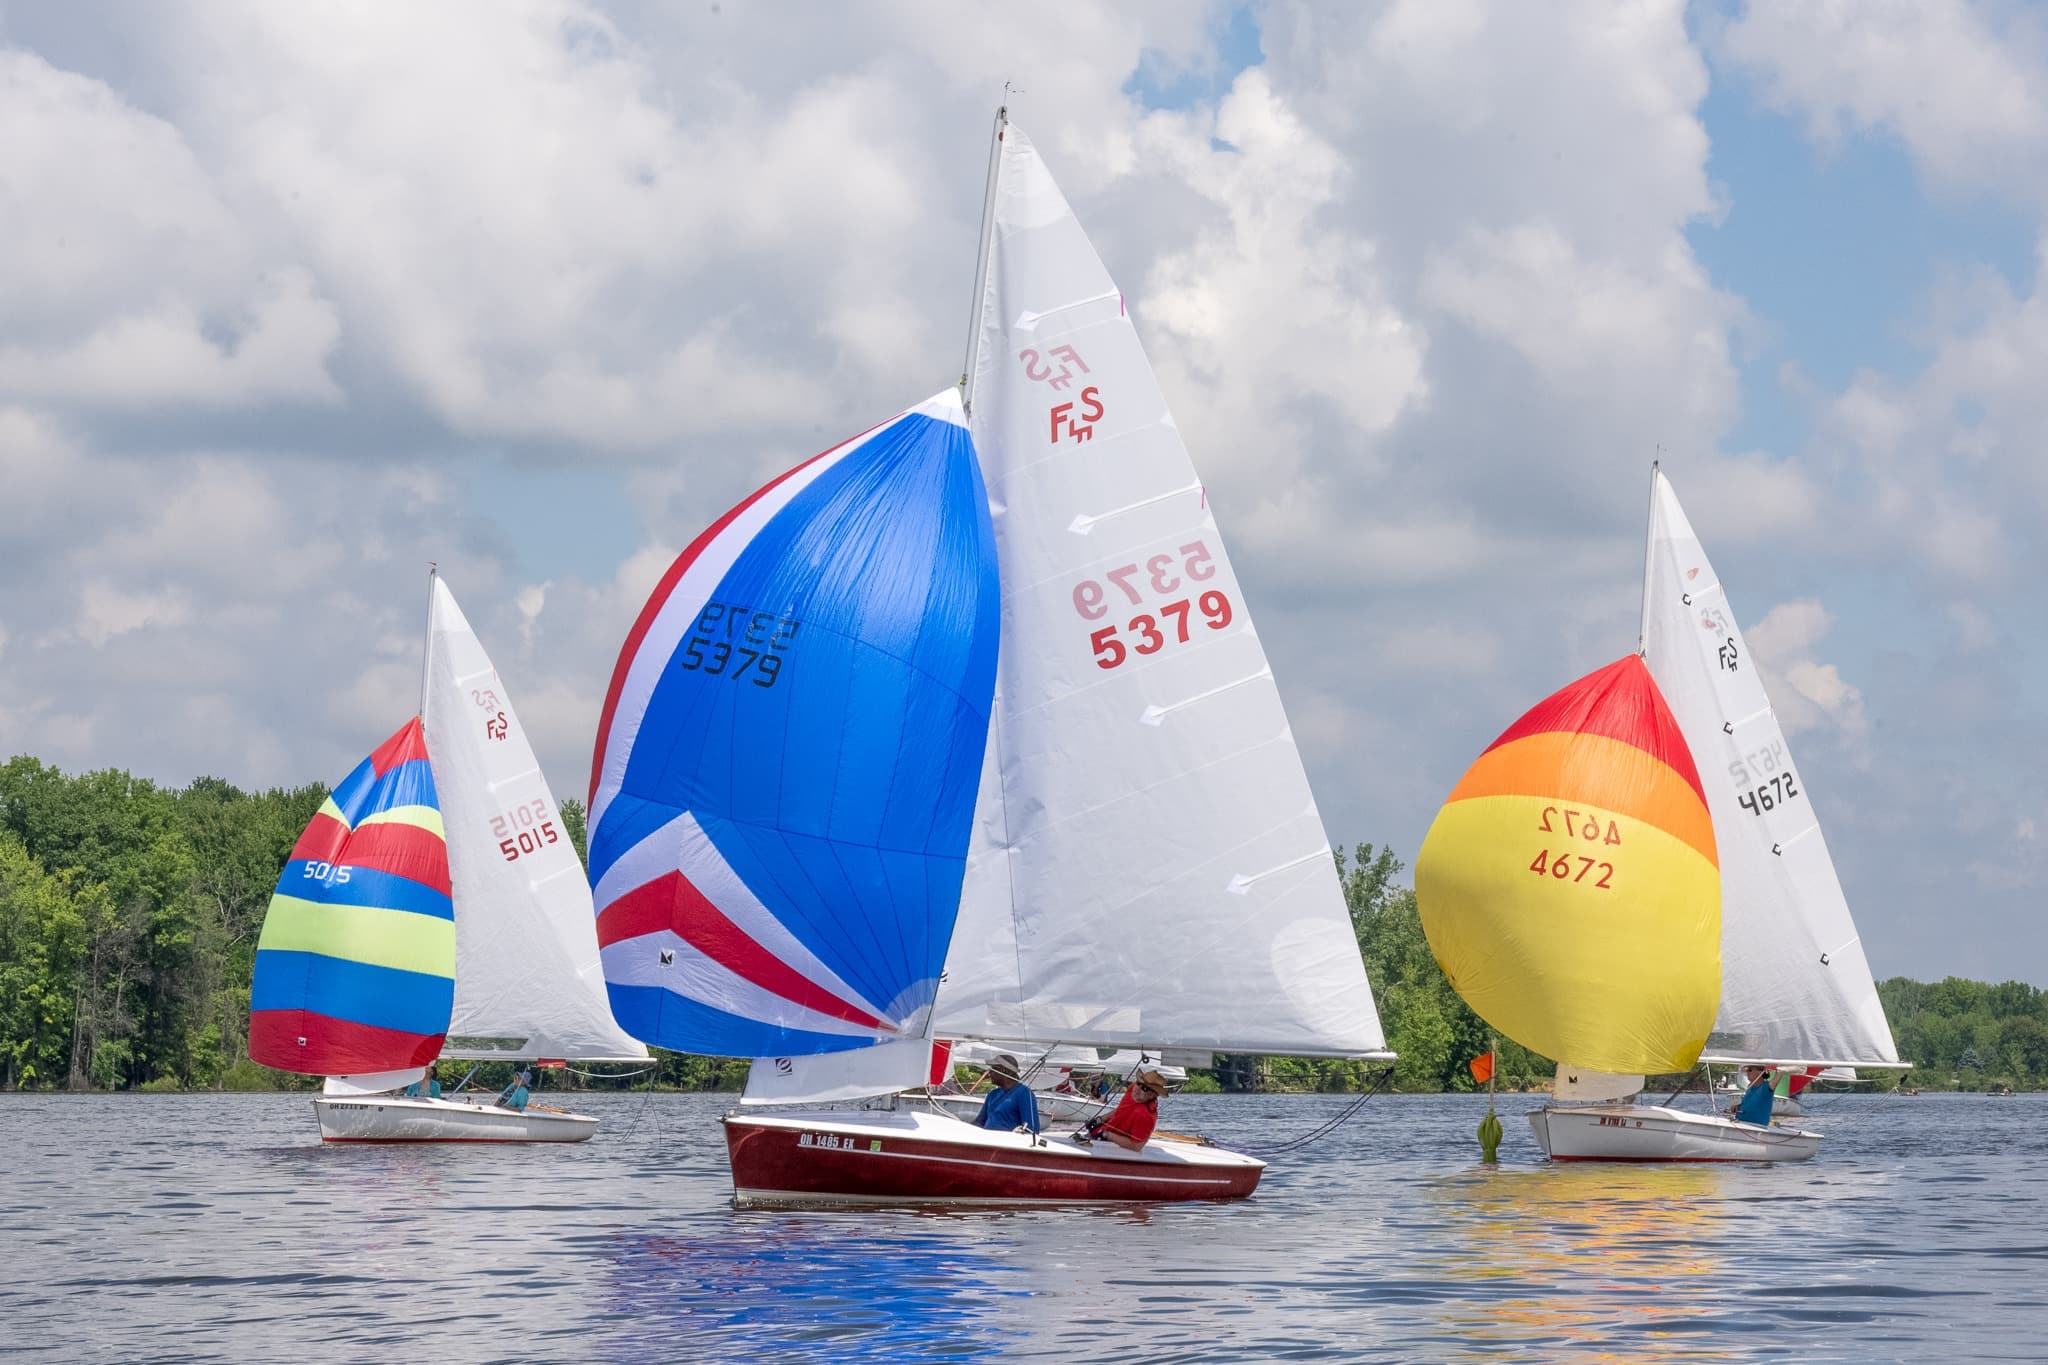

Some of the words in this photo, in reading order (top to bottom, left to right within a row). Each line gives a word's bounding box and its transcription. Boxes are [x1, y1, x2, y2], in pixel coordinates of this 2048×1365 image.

[1090, 590, 1233, 669] 5379
[682, 636, 782, 688] 5379
[1738, 772, 1798, 816] 4672
[499, 821, 558, 861] 5015
[303, 861, 353, 884] 5015
[1529, 849, 1613, 889] 4672
[800, 1133, 813, 1145] OH
